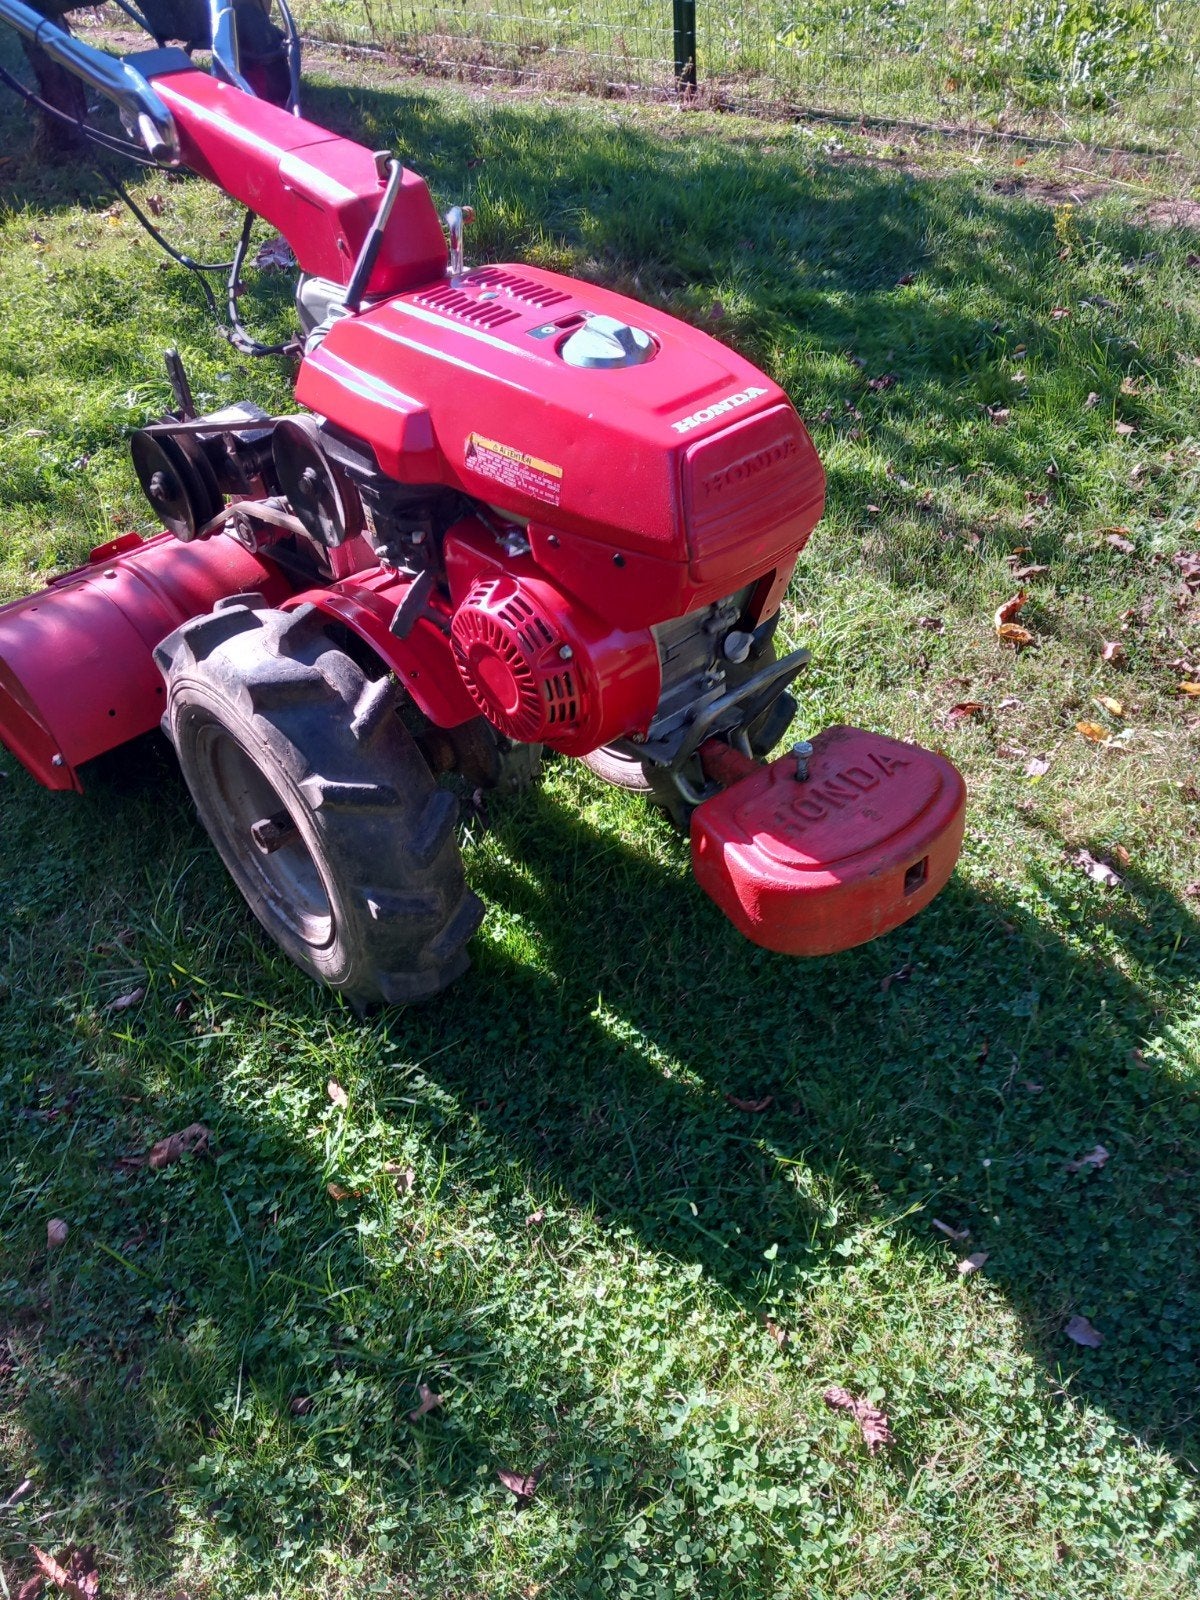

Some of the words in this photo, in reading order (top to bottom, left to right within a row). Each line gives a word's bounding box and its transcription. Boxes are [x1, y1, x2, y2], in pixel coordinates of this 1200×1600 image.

[671, 386, 768, 433] HONDA
[702, 440, 796, 494] HONDA
[774, 752, 912, 833] HONDA
